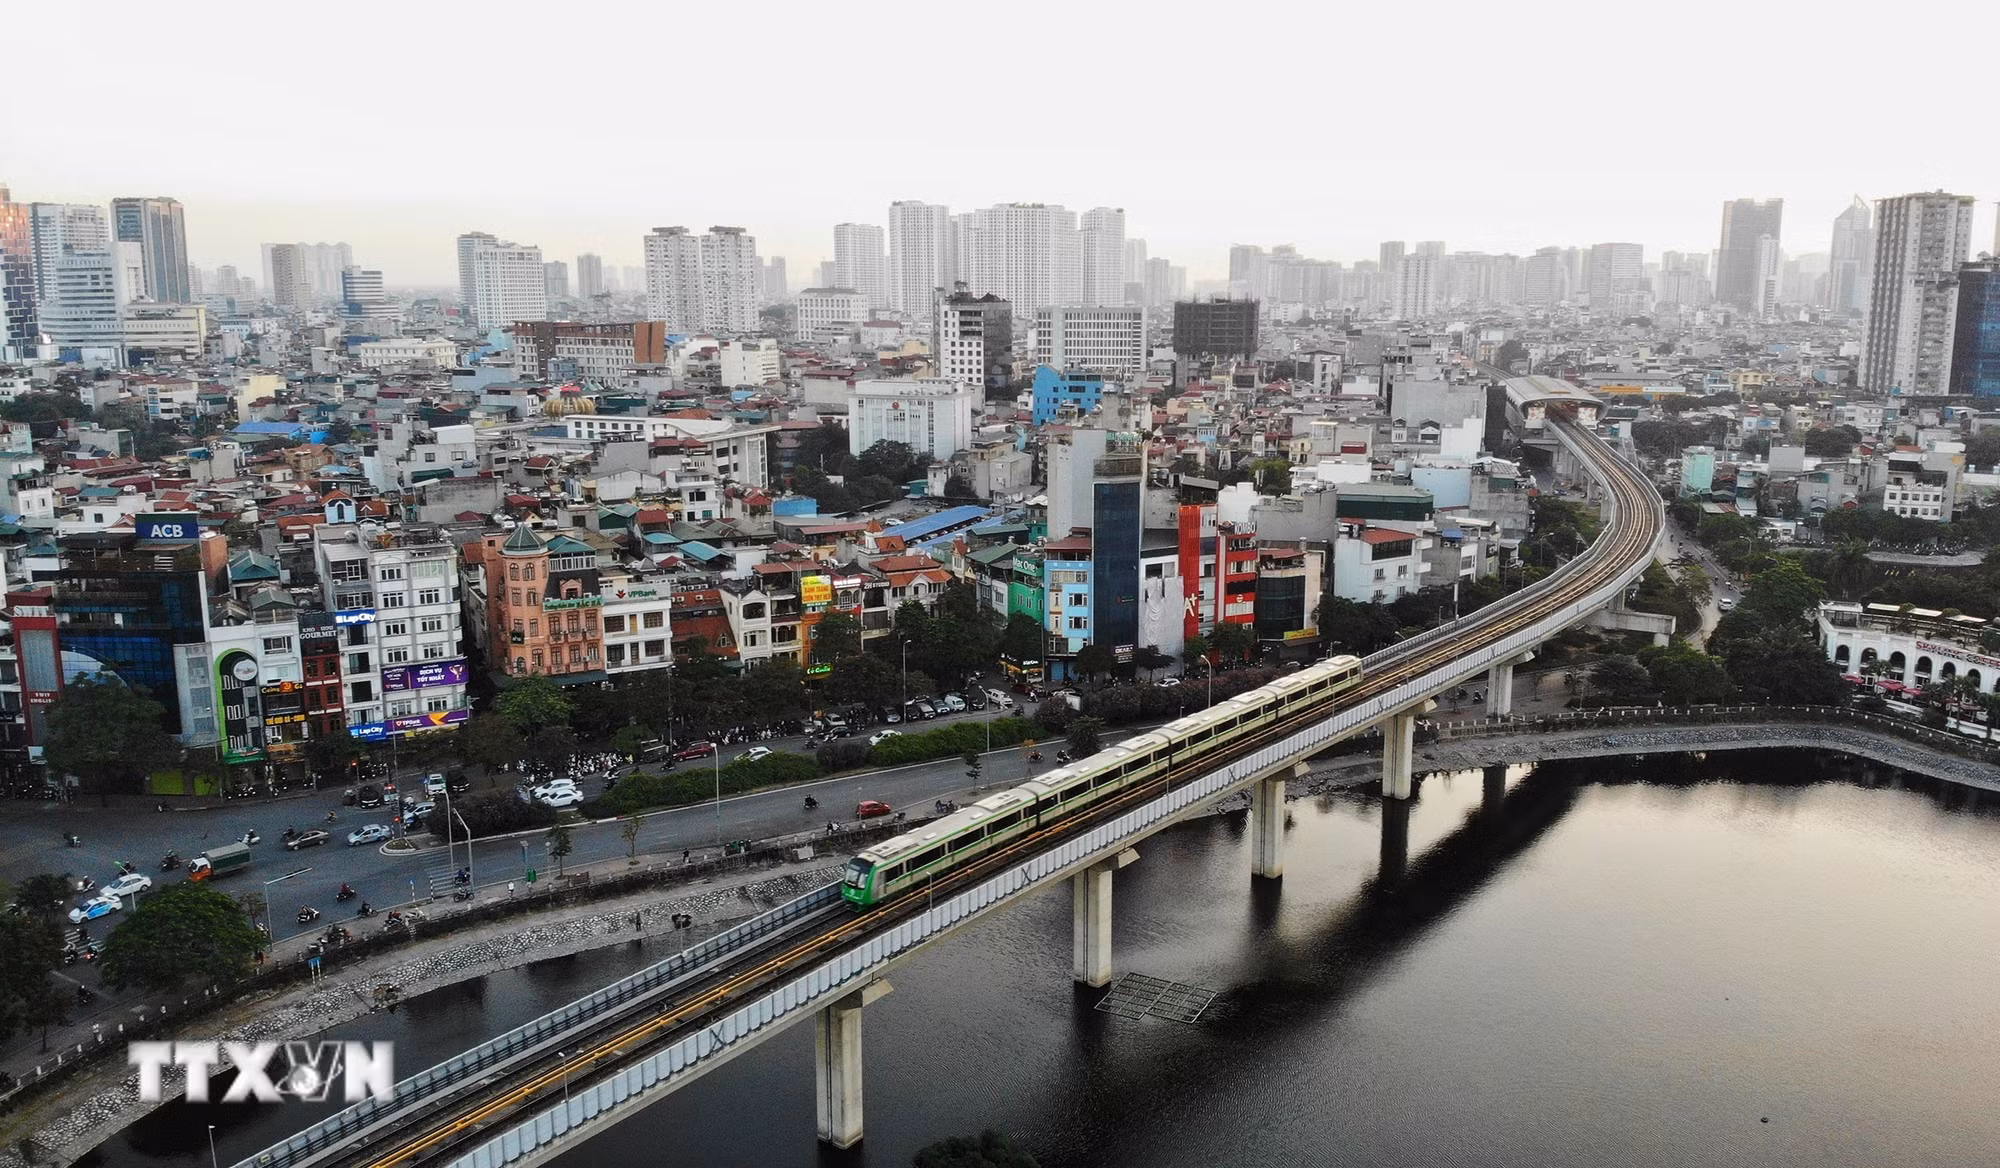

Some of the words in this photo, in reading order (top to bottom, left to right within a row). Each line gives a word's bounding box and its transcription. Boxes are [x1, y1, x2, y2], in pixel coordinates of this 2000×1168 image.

[151, 524, 183, 538] ACB
[1234, 522, 1256, 535] KOMBO
[1013, 556, 1023, 569] Mac
[627, 589, 657, 598] VPBank
[300, 630, 337, 640] GOURMET
